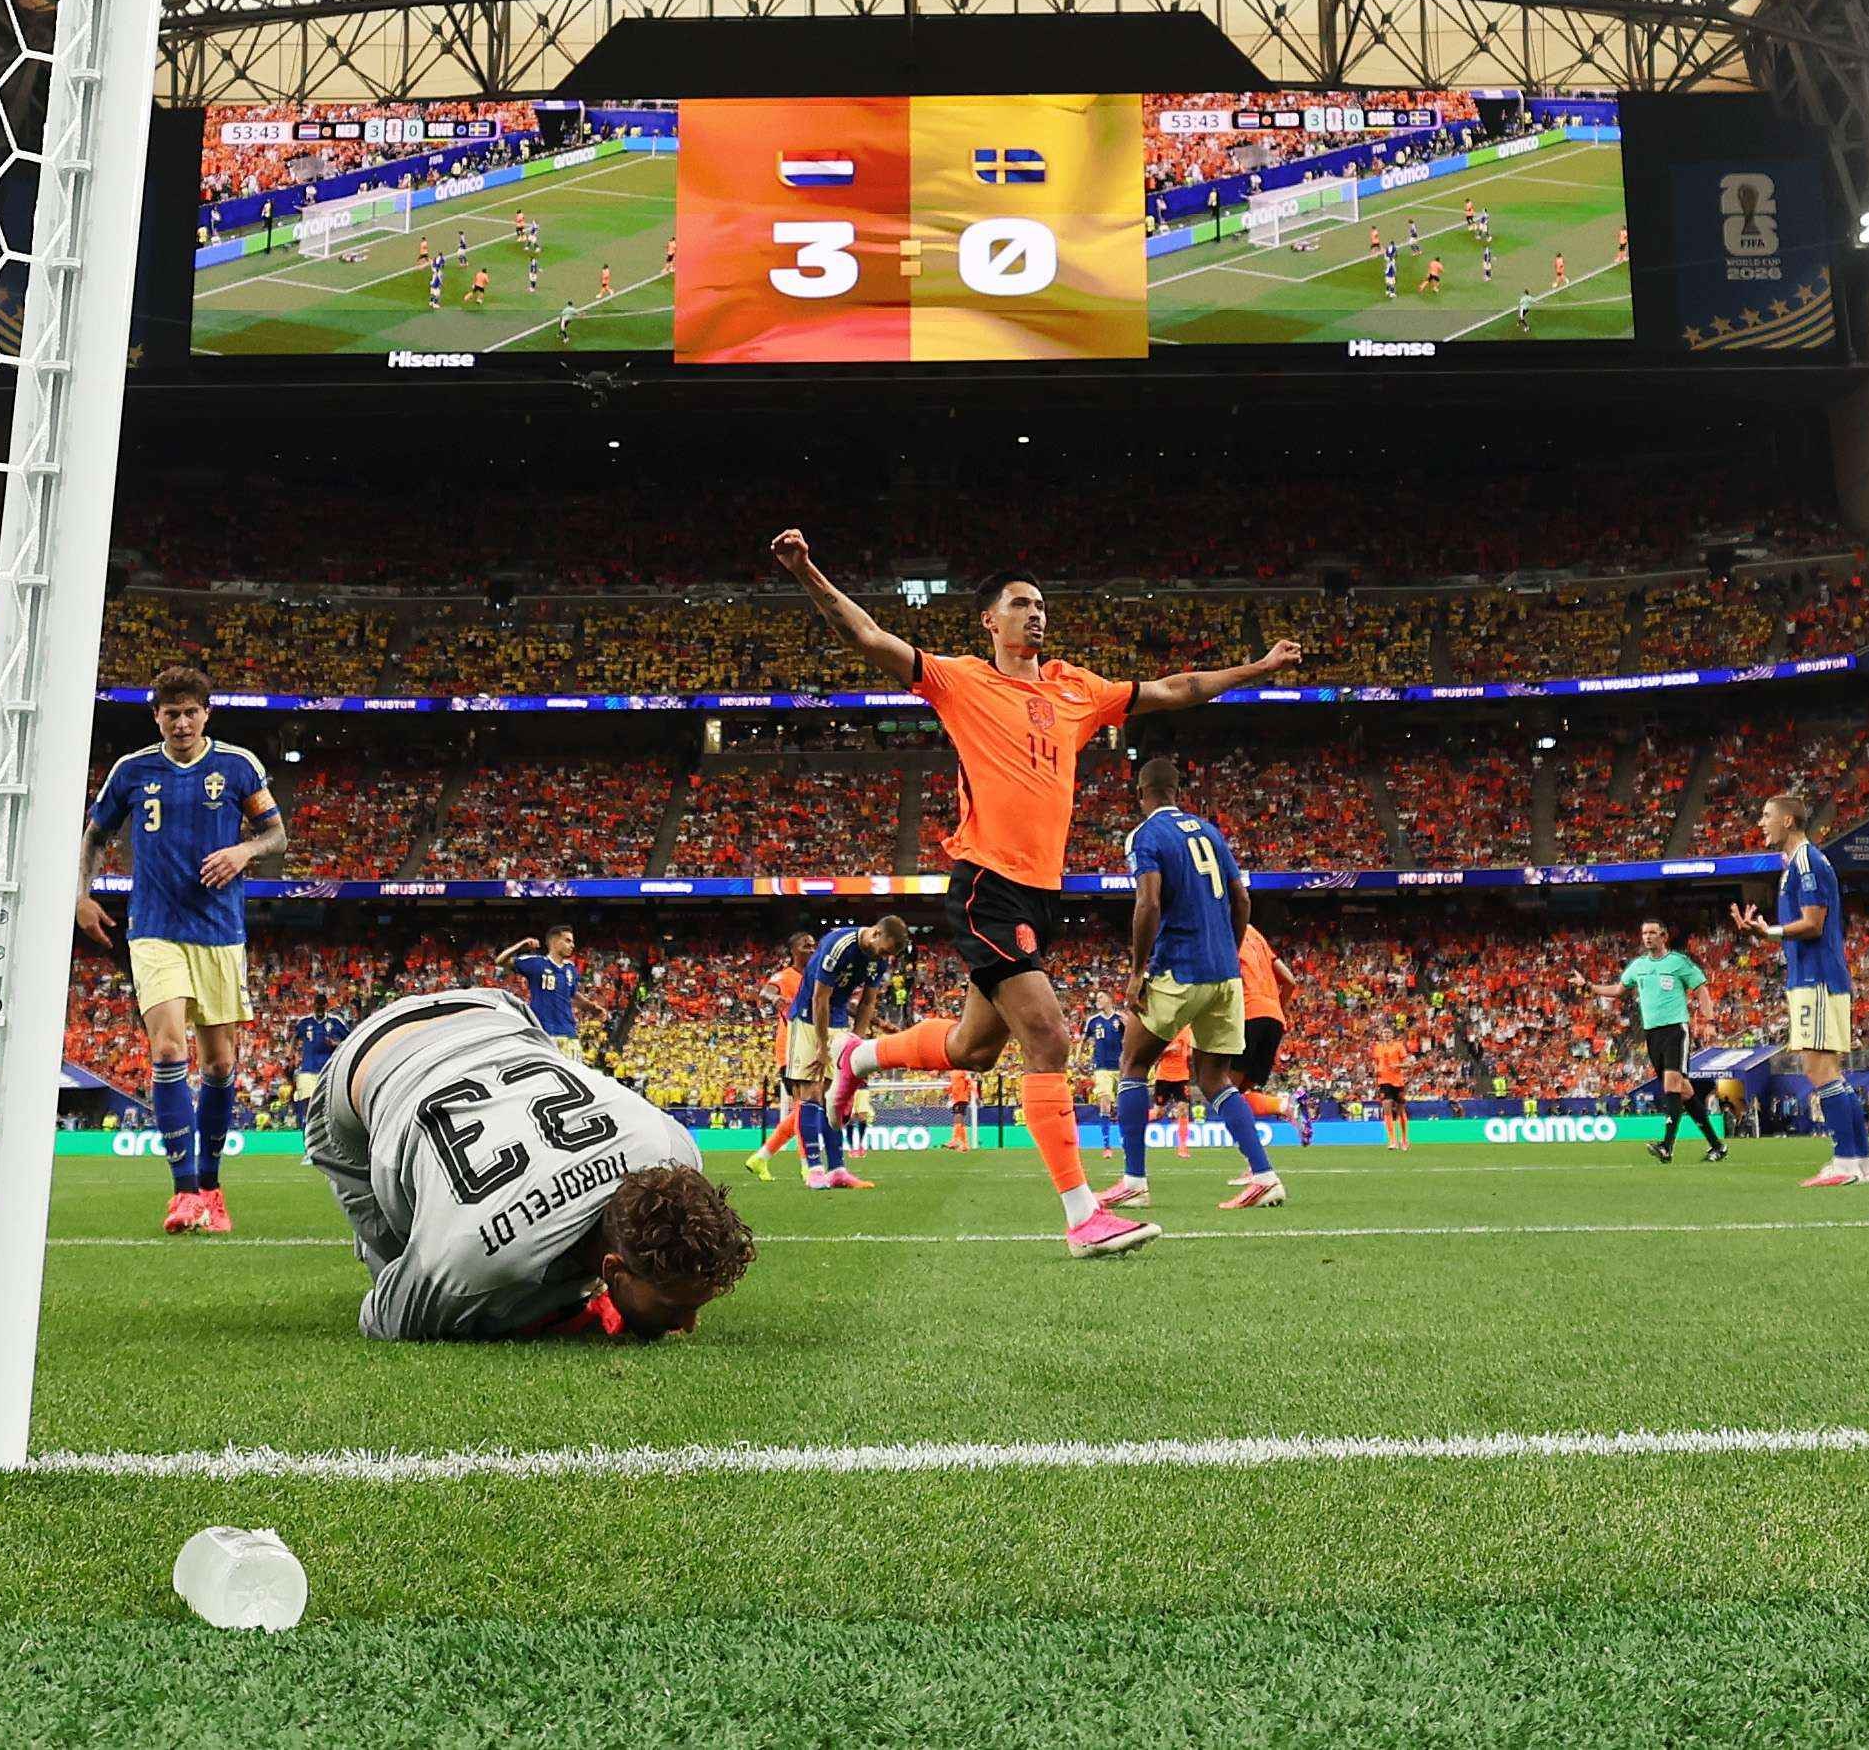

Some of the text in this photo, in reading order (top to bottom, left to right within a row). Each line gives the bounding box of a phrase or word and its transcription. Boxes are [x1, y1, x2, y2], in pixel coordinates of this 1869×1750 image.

[1171, 114, 1221, 129] 53:43
[1310, 113, 1320, 127] 3
[232, 125, 281, 140] 53:43
[369, 125, 379, 138] 3
[1498, 135, 1540, 158] aramco
[553, 147, 596, 169] aramco
[1381, 164, 1430, 190] aramco
[435, 172, 484, 201] aramco
[768, 221, 859, 298] 3
[958, 218, 1058, 296] 0
[1726, 257, 1782, 268] WORLD CUP
[1726, 267, 1782, 281] 2026
[1348, 339, 1436, 357] Hisense
[388, 350, 475, 368] Hisense
[1795, 657, 1849, 674] HOUSTON
[1432, 687, 1484, 698] HOUSTON
[1579, 679, 1603, 692] FIFA
[1603, 676, 1641, 690] WORLD
[1641, 676, 1662, 688] CUP
[364, 699, 416, 710] HOUSTON
[719, 697, 772, 707] HOUSTON
[1026, 731, 1059, 776] 14
[143, 799, 162, 833] 3
[1187, 836, 1225, 900] 4
[1101, 875, 1131, 889] FIFA
[1397, 872, 1464, 885] HOUSTON
[379, 883, 446, 895] HOUSTON
[1800, 1005, 1811, 1028] 2
[415, 1060, 619, 1205] 23
[1145, 1121, 1274, 1148] aramo
[1484, 1115, 1618, 1143] aramco
